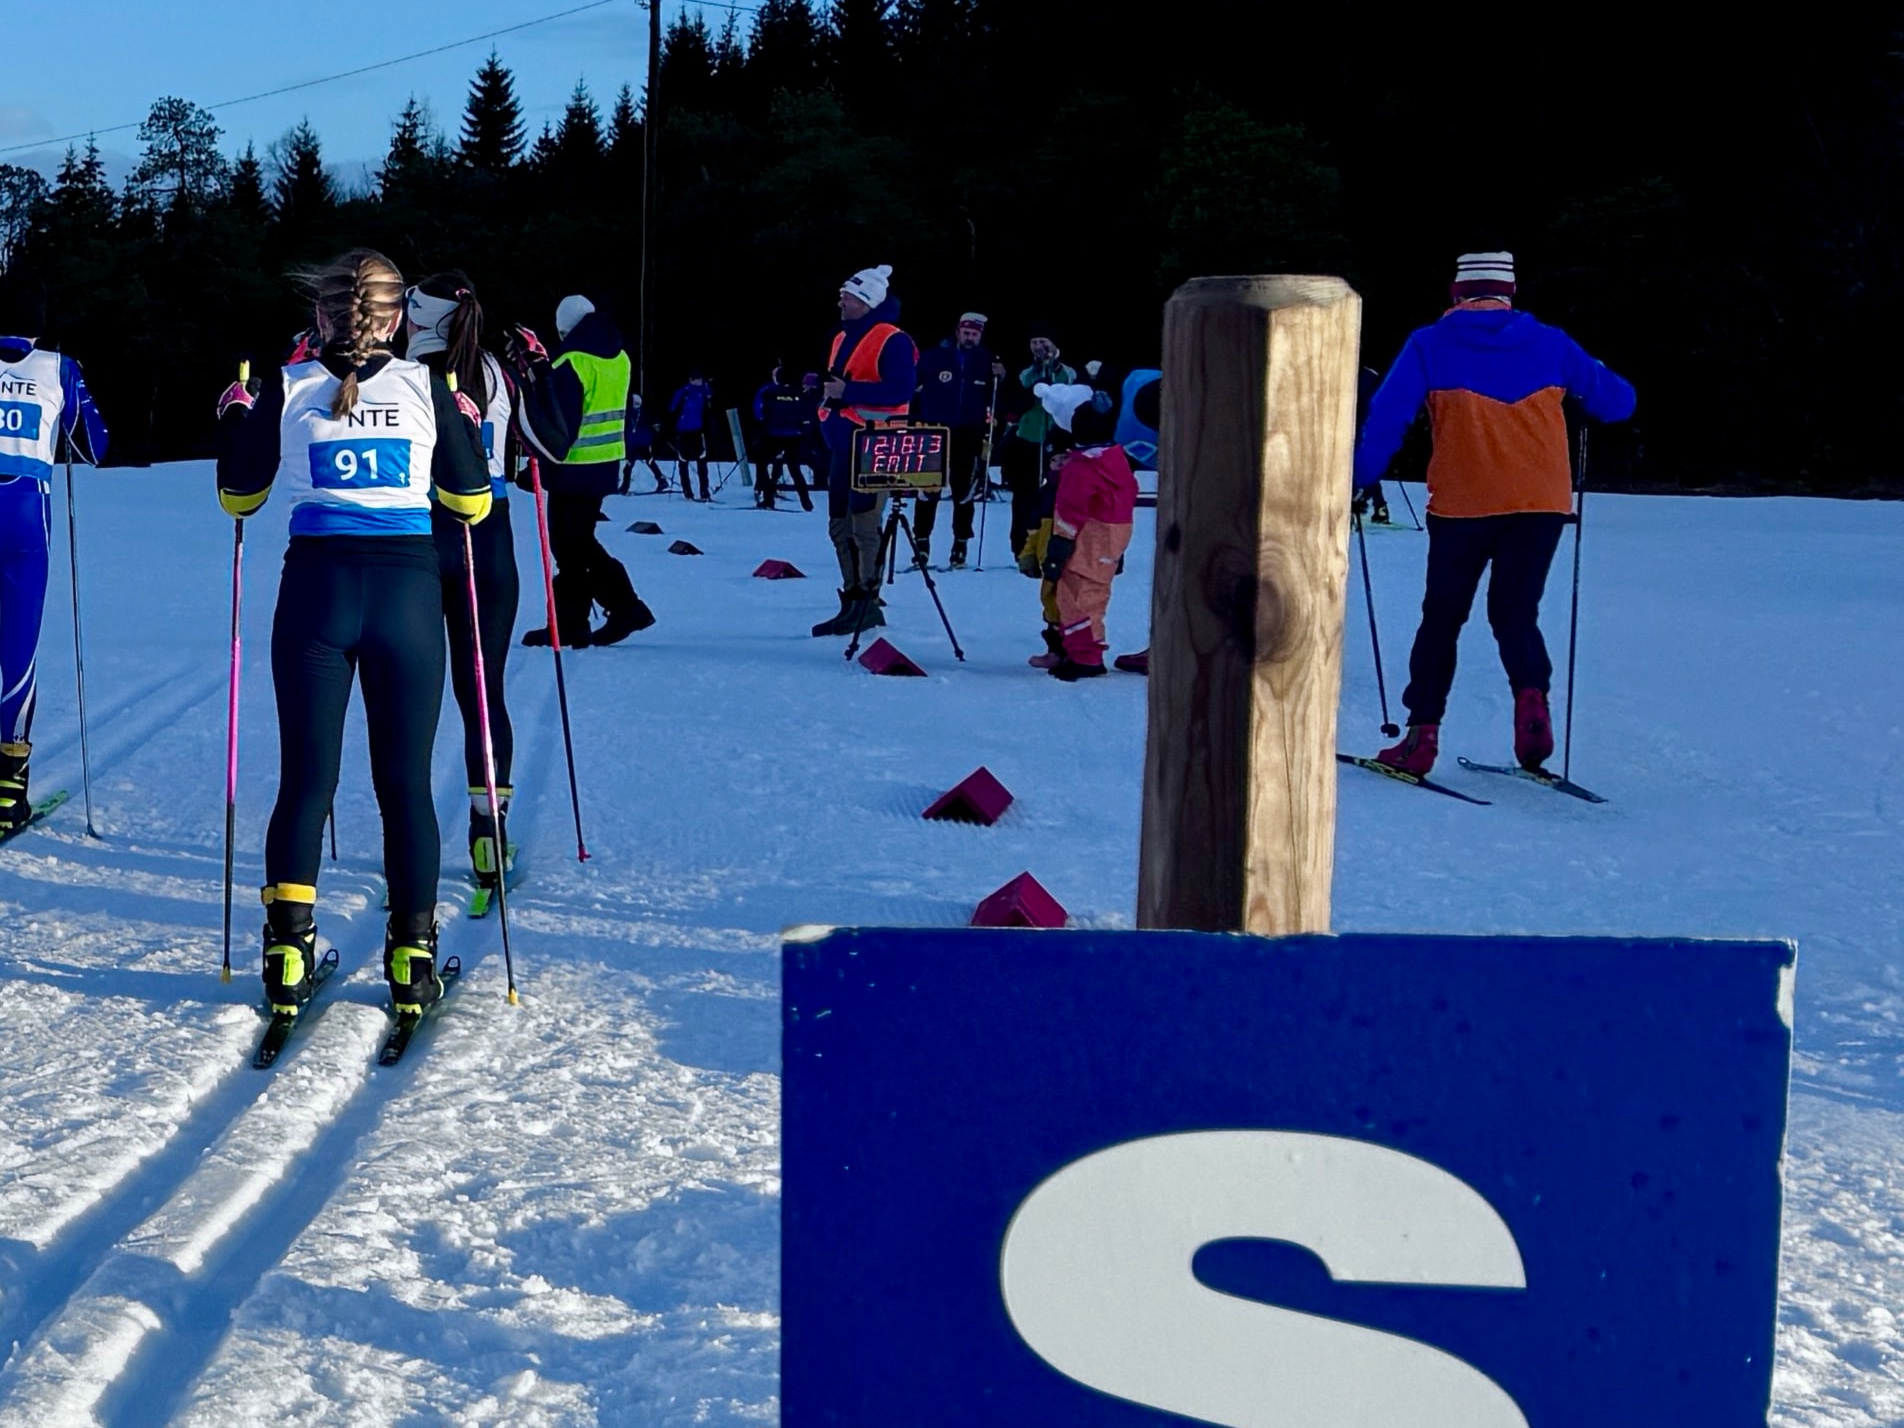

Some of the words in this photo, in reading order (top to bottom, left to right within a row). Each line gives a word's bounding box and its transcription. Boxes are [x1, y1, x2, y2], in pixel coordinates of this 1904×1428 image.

[1, 381, 37, 396] NTE
[348, 409, 400, 428] NTE
[334, 449, 378, 481] 91
